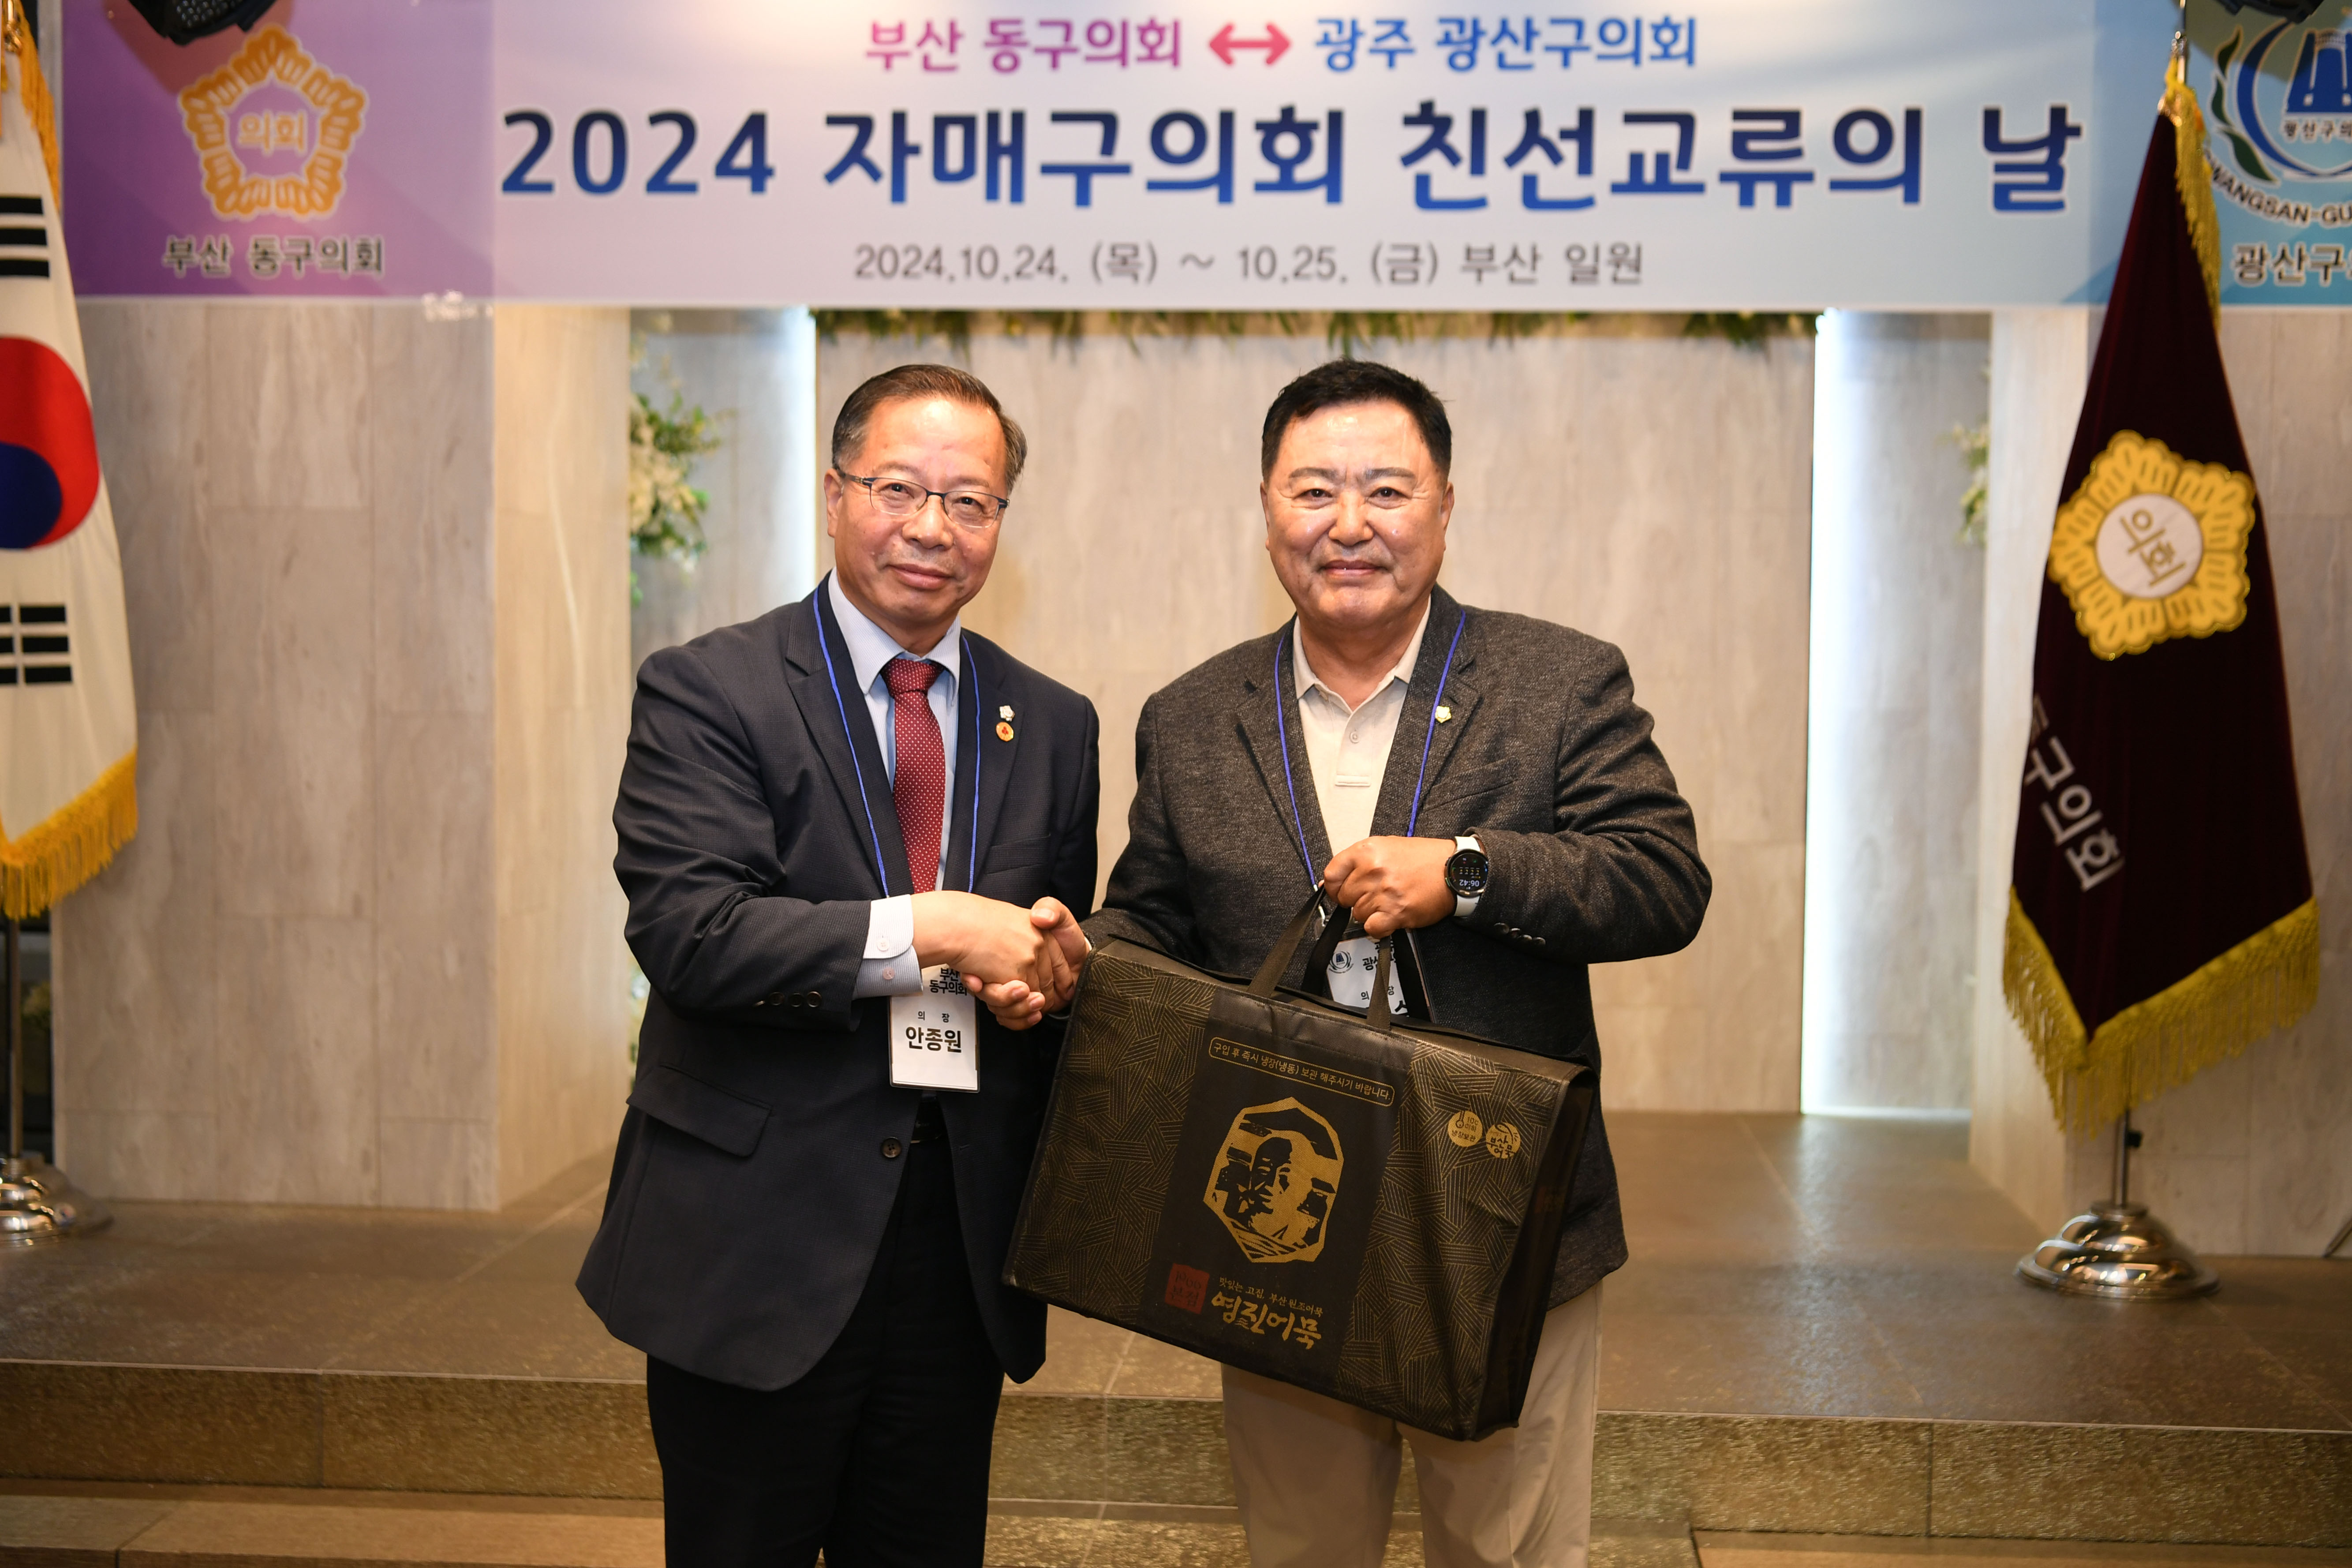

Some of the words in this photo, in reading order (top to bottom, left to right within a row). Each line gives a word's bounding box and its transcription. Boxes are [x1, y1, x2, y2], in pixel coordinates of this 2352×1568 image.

[866, 19, 964, 73] 부산
[983, 18, 1182, 74] 동구의회
[1314, 17, 1416, 73] 광주
[1436, 15, 1697, 73] 광산구의회
[238, 110, 308, 151] 의회
[501, 110, 775, 195] 2024
[823, 104, 1345, 208] 자매구의회
[1400, 100, 1923, 212] 친선교류의
[1982, 104, 2083, 213] 날
[164, 236, 232, 275] 부산
[248, 236, 384, 275] 동구의회
[855, 244, 1069, 284] 2024.10.24.
[1092, 241, 1158, 285] (목)
[1238, 245, 1348, 284] 10.25.
[1371, 240, 1439, 285] (금)
[1461, 244, 1541, 285] 부산
[1565, 243, 1643, 285] 일원
[2232, 243, 2352, 286] 광산구
[2119, 508, 2187, 587] 의회
[2024, 693, 2125, 892] 구의회
[930, 980, 967, 996] 동구의회
[940, 967, 960, 982] 부산
[906, 1026, 961, 1053] 안종원
[1214, 1042, 1229, 1055] 구입
[1231, 1048, 1239, 1058] 후
[1241, 1051, 1258, 1063] 즉시
[1261, 1055, 1299, 1075] 냉장(냉동)
[1301, 1067, 1318, 1080] 보관
[1320, 1072, 1353, 1090] 해주시기
[1355, 1082, 1391, 1100] 바랍니다.
[1212, 1291, 1322, 1350] 영진어묵
